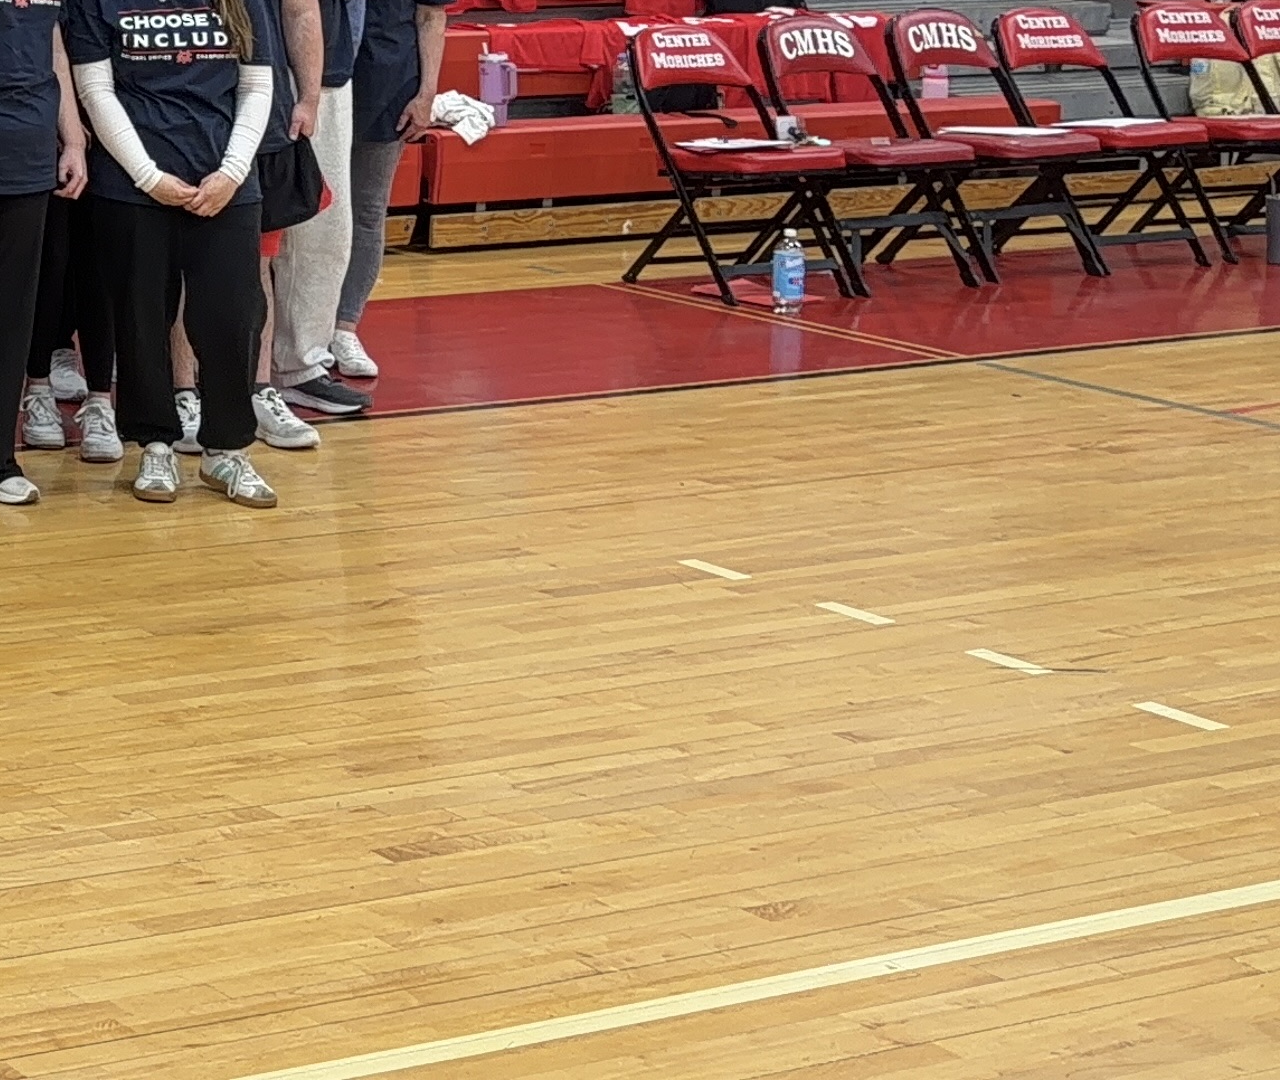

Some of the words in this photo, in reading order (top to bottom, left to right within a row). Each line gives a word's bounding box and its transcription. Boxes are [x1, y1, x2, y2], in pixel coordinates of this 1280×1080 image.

[120, 14, 209, 29] CHOOSE
[1014, 14, 1069, 29] CENTER
[1153, 10, 1212, 23] CENTER
[651, 32, 711, 48] CENTER
[780, 29, 854, 59] CMHS
[908, 22, 977, 52] CMHS
[651, 53, 725, 68] MORICHES
